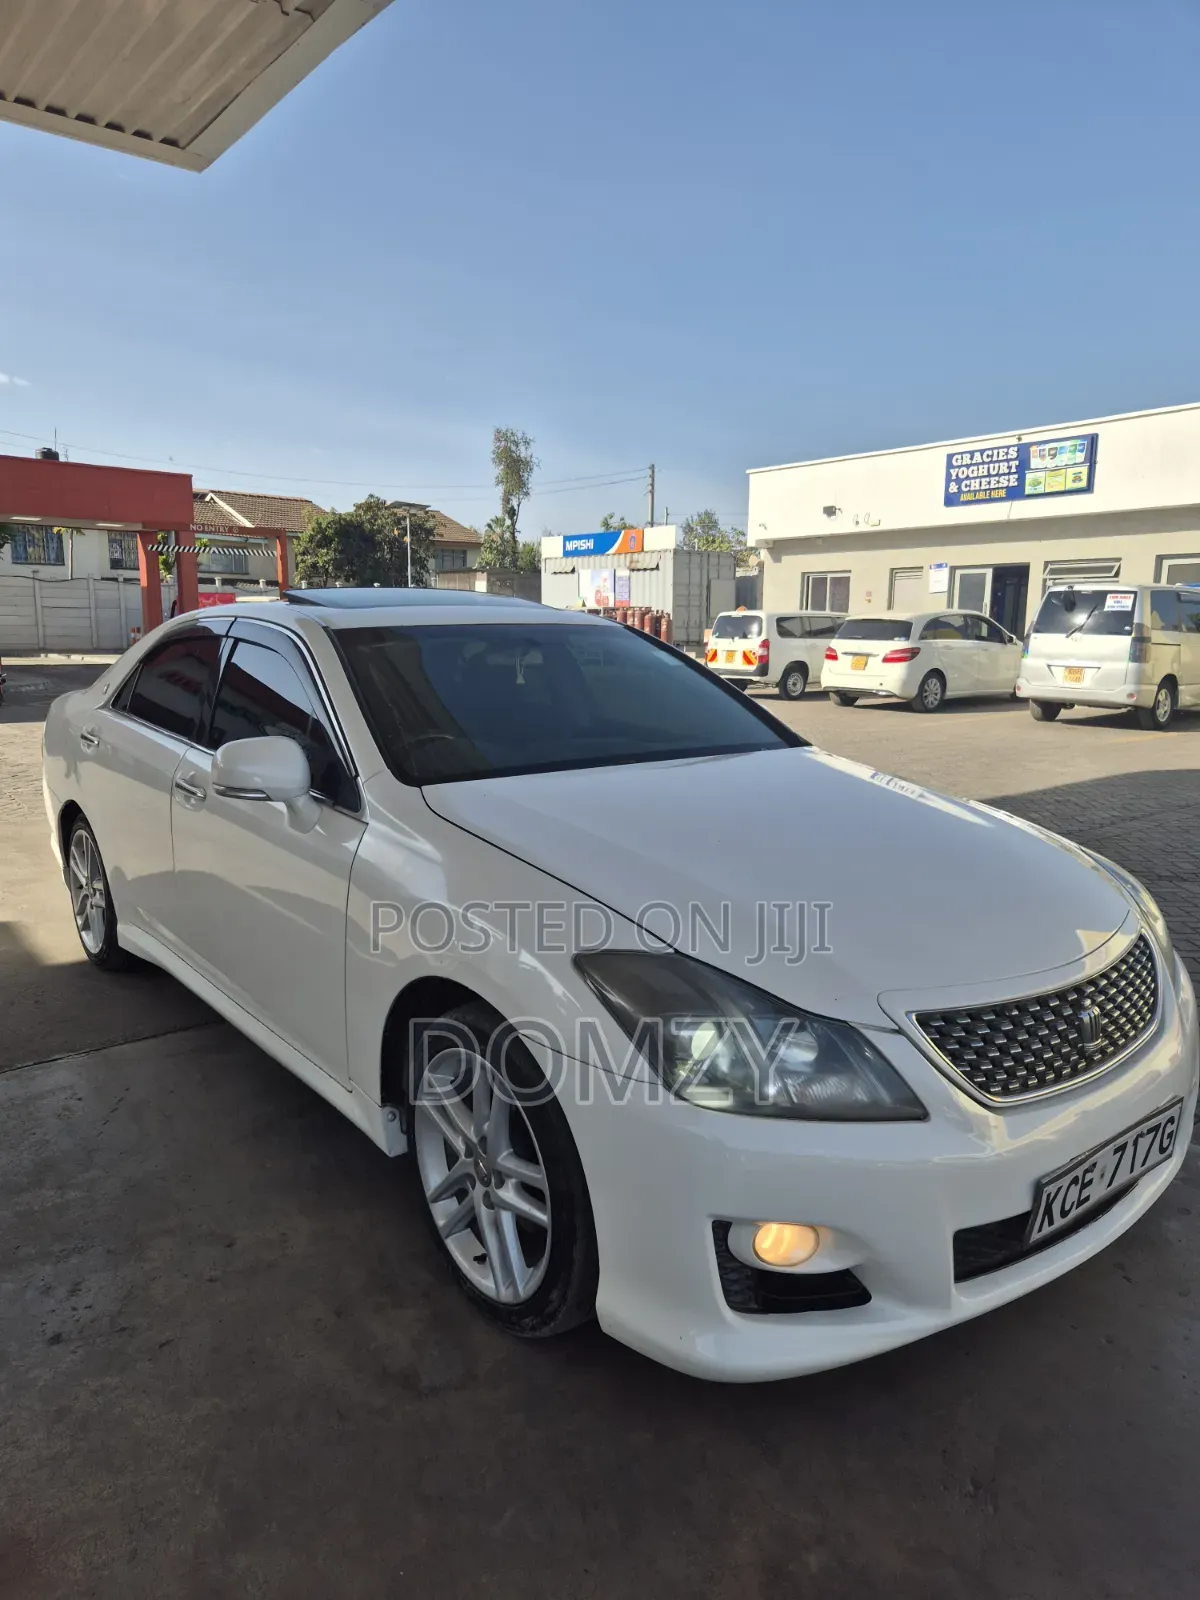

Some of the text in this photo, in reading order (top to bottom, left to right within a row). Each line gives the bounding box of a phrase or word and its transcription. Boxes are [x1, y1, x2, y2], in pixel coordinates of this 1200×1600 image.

[952, 446, 1018, 466] GRACIES
[949, 460, 1019, 480] YOGHURT
[948, 474, 1018, 493] & CHEESE
[960, 488, 1007, 501] AVAILABLE HERE
[190, 523, 230, 533] NO ENTRY
[565, 538, 594, 551] MPISHI
[1037, 1115, 1175, 1234] KCE 717G
